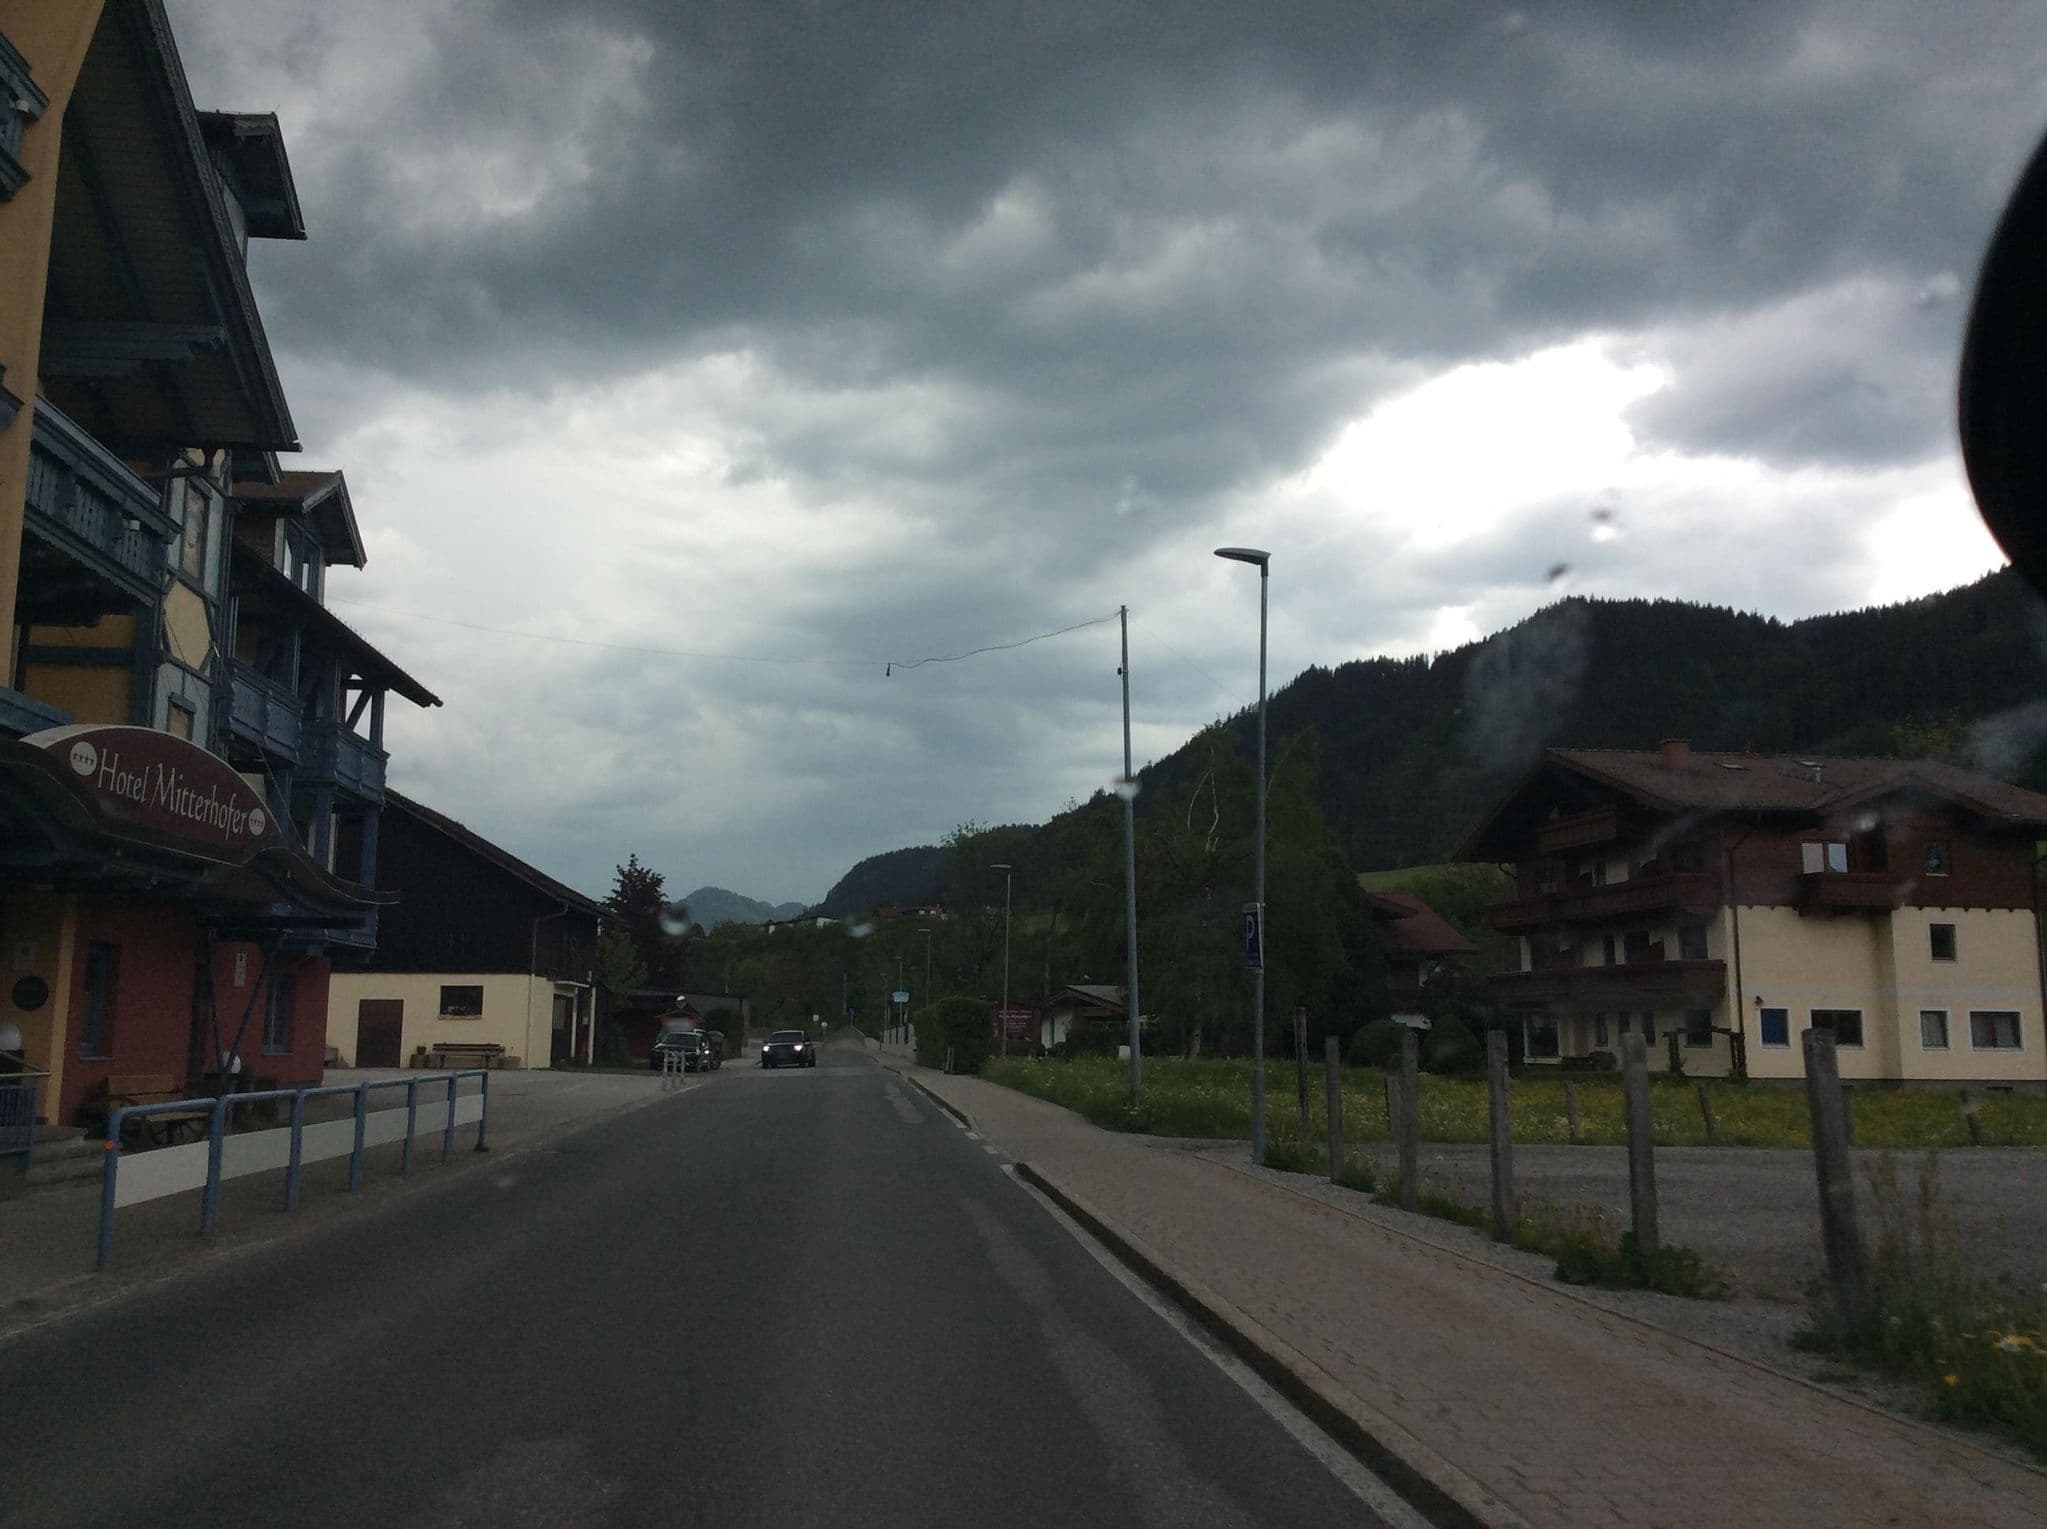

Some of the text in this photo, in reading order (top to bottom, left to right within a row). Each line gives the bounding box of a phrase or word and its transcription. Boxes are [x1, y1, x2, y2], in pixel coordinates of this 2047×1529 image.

[97, 748, 247, 840] Hotel Mitterhofer
[1246, 914, 1255, 953] P
